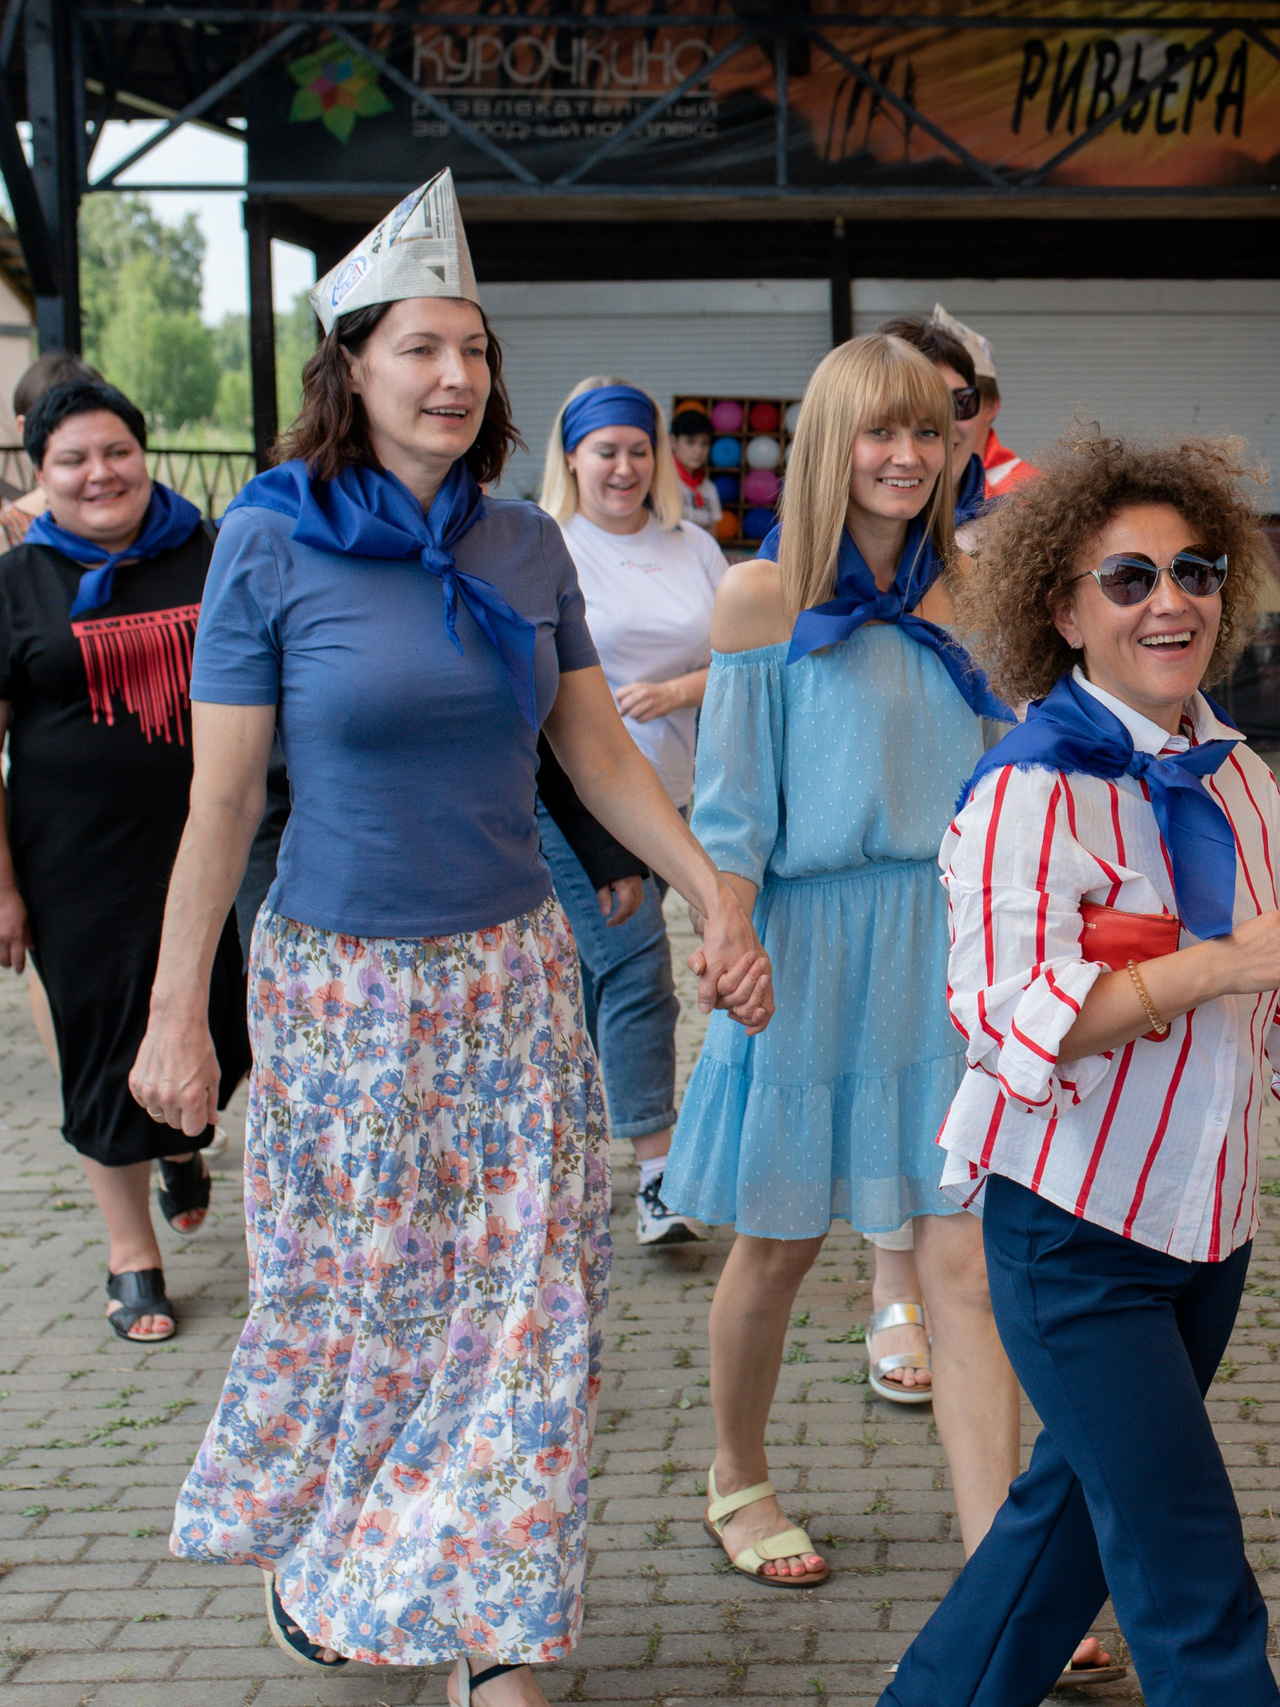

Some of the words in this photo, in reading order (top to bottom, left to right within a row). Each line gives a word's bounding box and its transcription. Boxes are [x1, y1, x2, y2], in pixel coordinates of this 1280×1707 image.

[411, 34, 717, 85] КУРОЧКИНО
[1011, 38, 1248, 137] РИВЬЕРА
[411, 100, 718, 118] рзвлекательый
[161, 608, 199, 620] STYL
